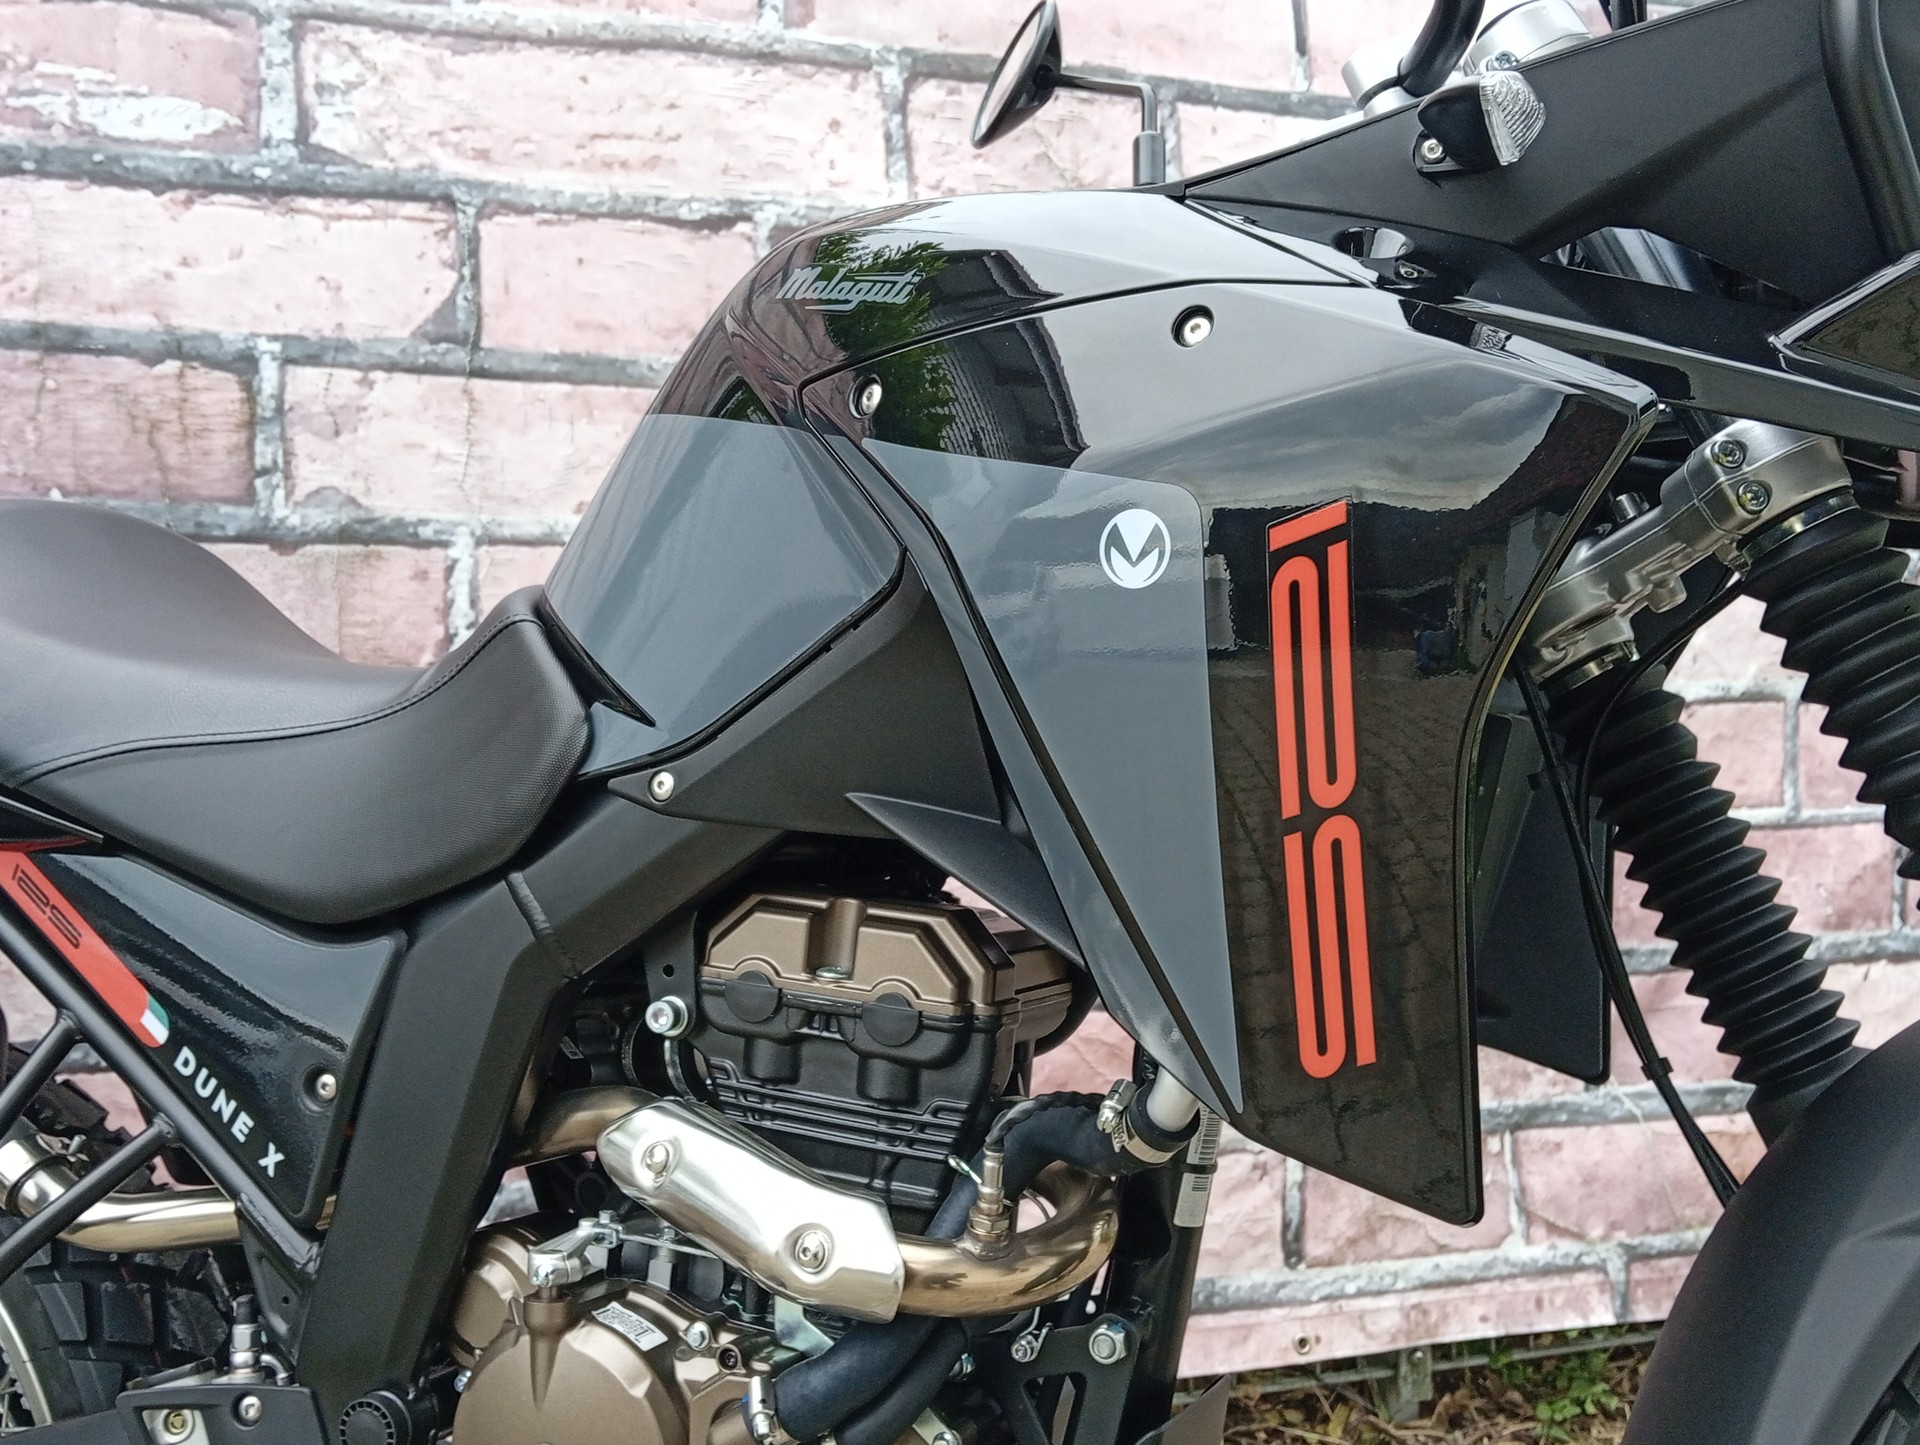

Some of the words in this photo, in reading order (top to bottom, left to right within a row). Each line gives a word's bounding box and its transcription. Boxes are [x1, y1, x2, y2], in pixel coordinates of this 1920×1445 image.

[775, 263, 923, 311] Malaguti
[1268, 498, 1377, 1079] 125
[12, 863, 82, 949] 125
[173, 1045, 255, 1144] DUNE
[257, 1141, 285, 1178] X
